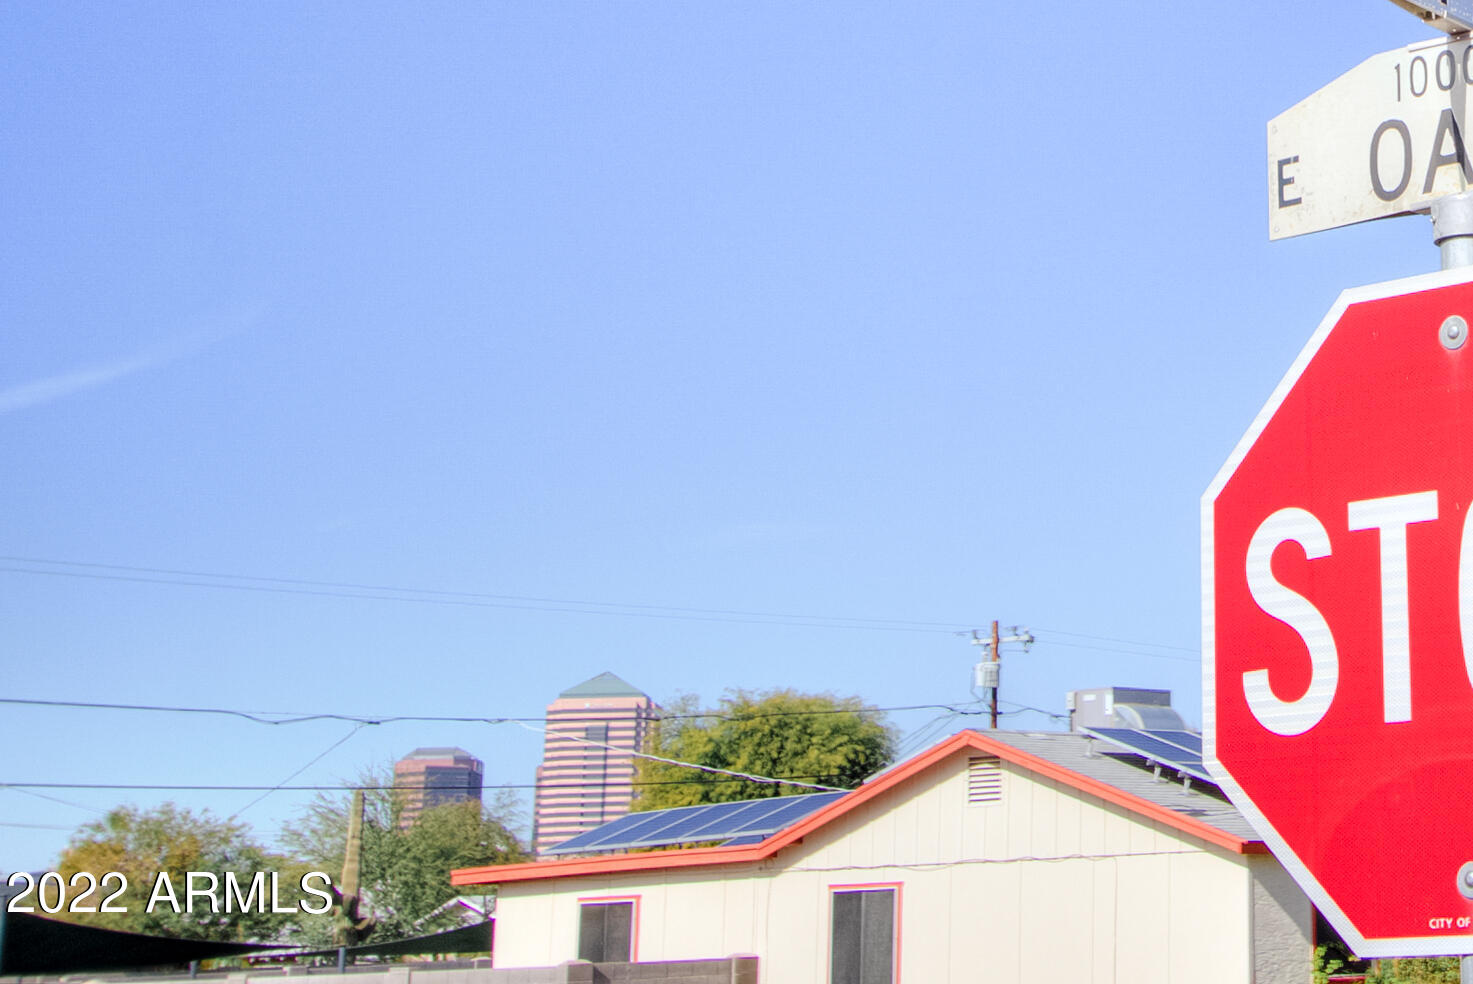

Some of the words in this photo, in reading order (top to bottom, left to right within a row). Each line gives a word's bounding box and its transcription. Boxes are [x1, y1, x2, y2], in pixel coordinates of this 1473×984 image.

[1277, 156, 1302, 209] E
[1429, 918, 1453, 929] CITY
[1456, 917, 1470, 928] OF
